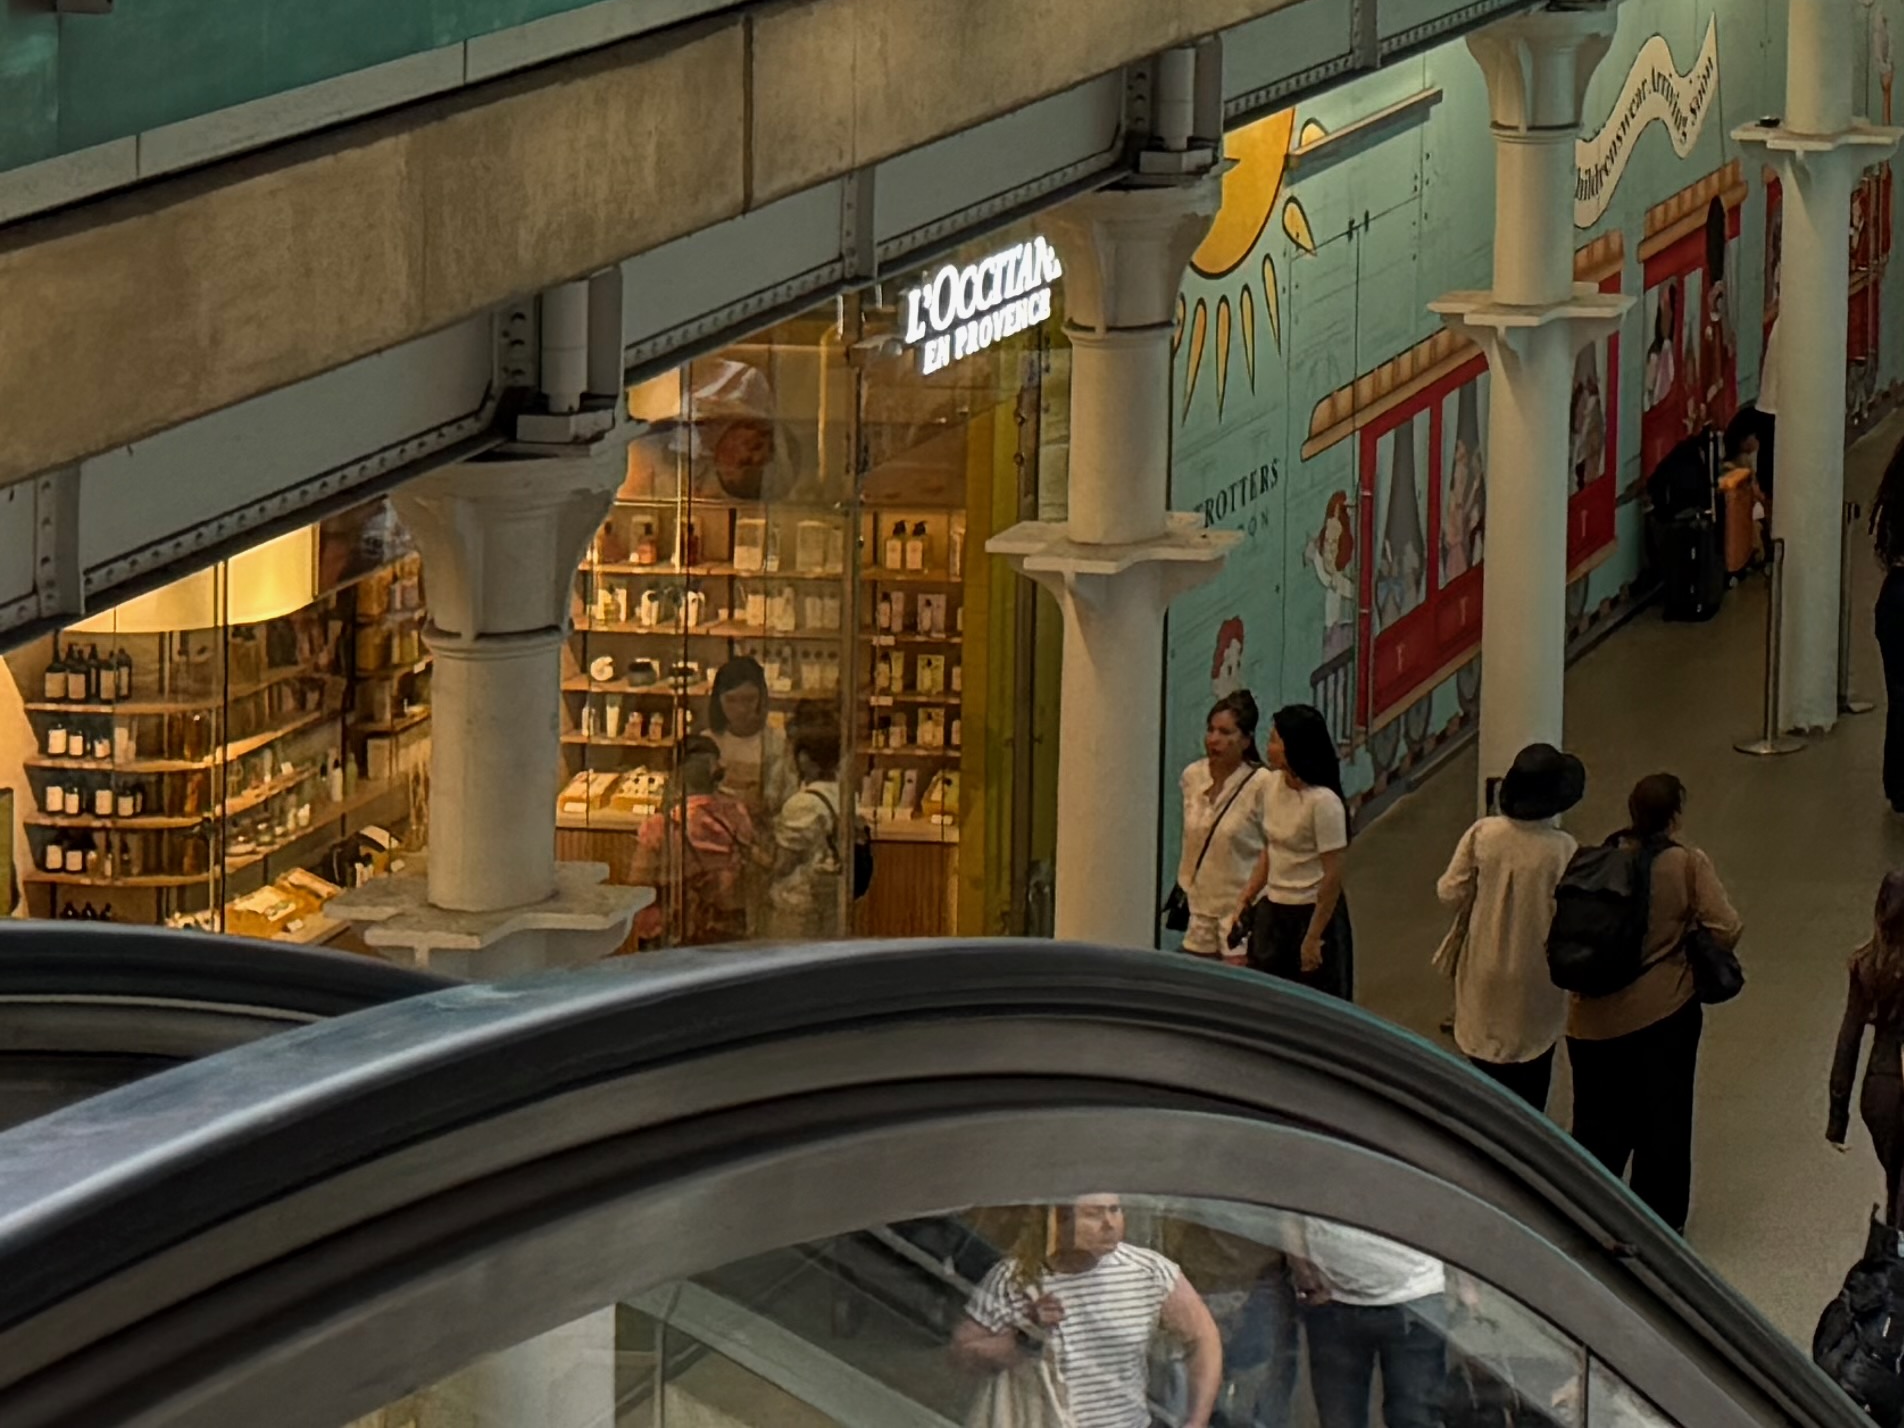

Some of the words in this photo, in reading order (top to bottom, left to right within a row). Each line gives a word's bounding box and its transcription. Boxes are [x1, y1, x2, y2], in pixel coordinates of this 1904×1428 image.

[1575, 78, 1648, 200] hildrenswear
[1651, 66, 1688, 144] Arriving
[1689, 56, 1714, 126] Soon
[923, 334, 951, 375] EN
[955, 287, 1051, 360] PROVENCE
